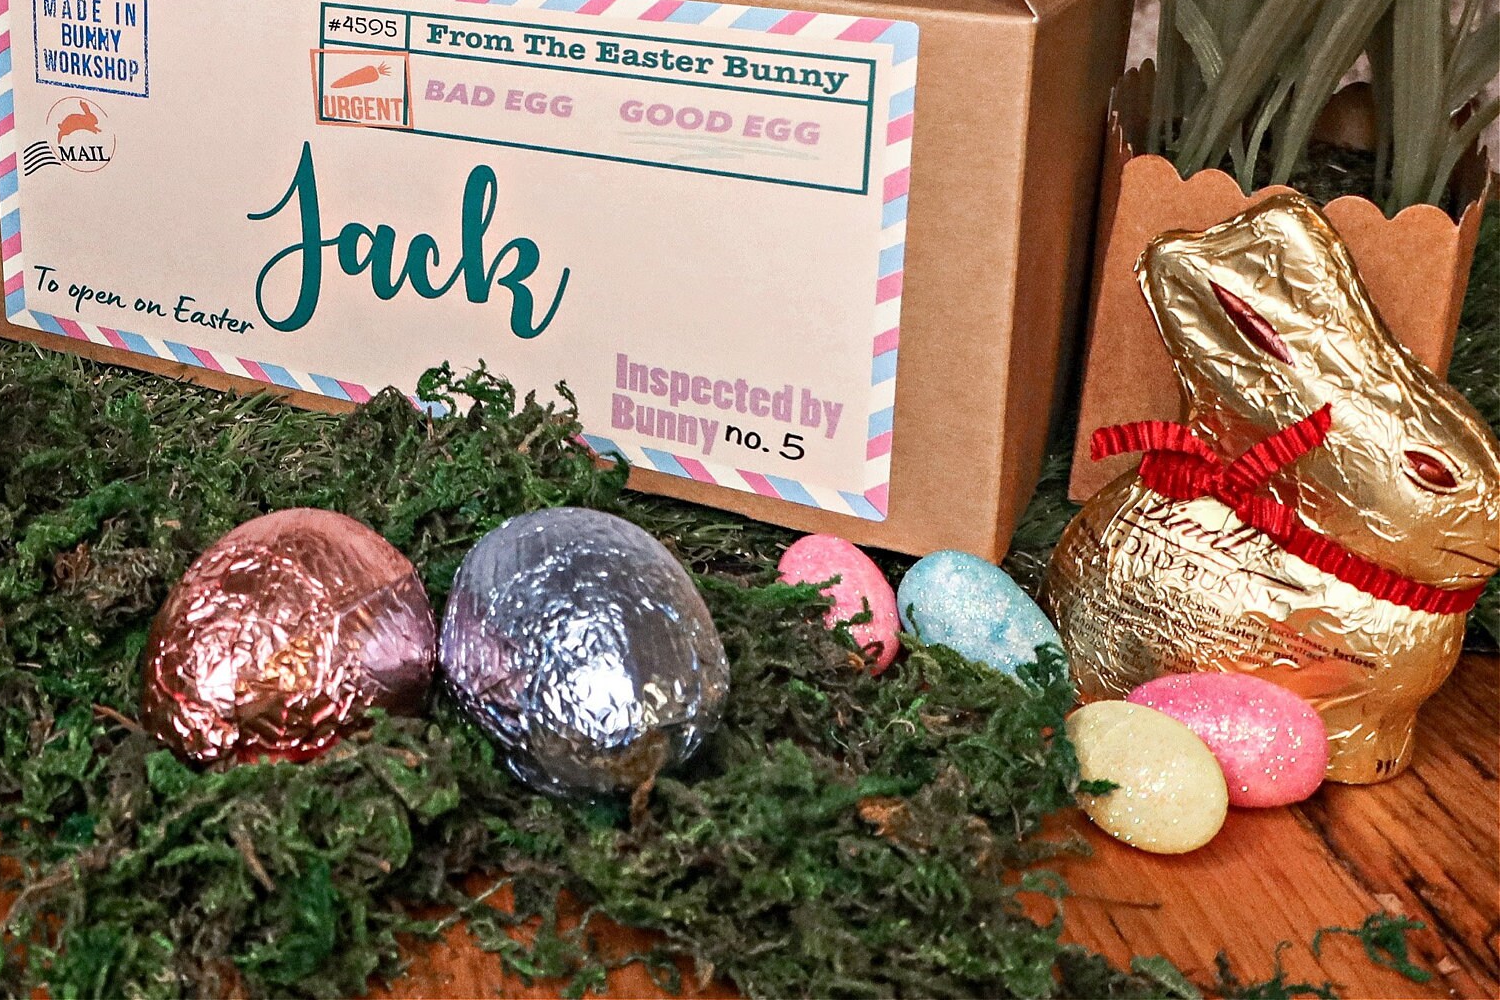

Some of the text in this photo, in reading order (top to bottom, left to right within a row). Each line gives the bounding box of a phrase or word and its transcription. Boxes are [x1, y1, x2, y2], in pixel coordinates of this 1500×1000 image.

[114, 1, 137, 26] IN
[328, 14, 398, 39] #4595
[61, 23, 122, 53] BUNNY
[43, 48, 139, 82] WORKSHOP
[426, 22, 850, 96] From The Easter Bunny
[323, 95, 404, 122] URGENT
[423, 78, 574, 118] BAD EGG
[618, 100, 821, 146] GOOD EGG
[57, 146, 111, 163] MAIL
[247, 140, 571, 339] Jack
[33, 264, 255, 335] To open on Easter
[615, 352, 844, 439] Inspected by
[611, 392, 805, 461] Bunny no. 5
